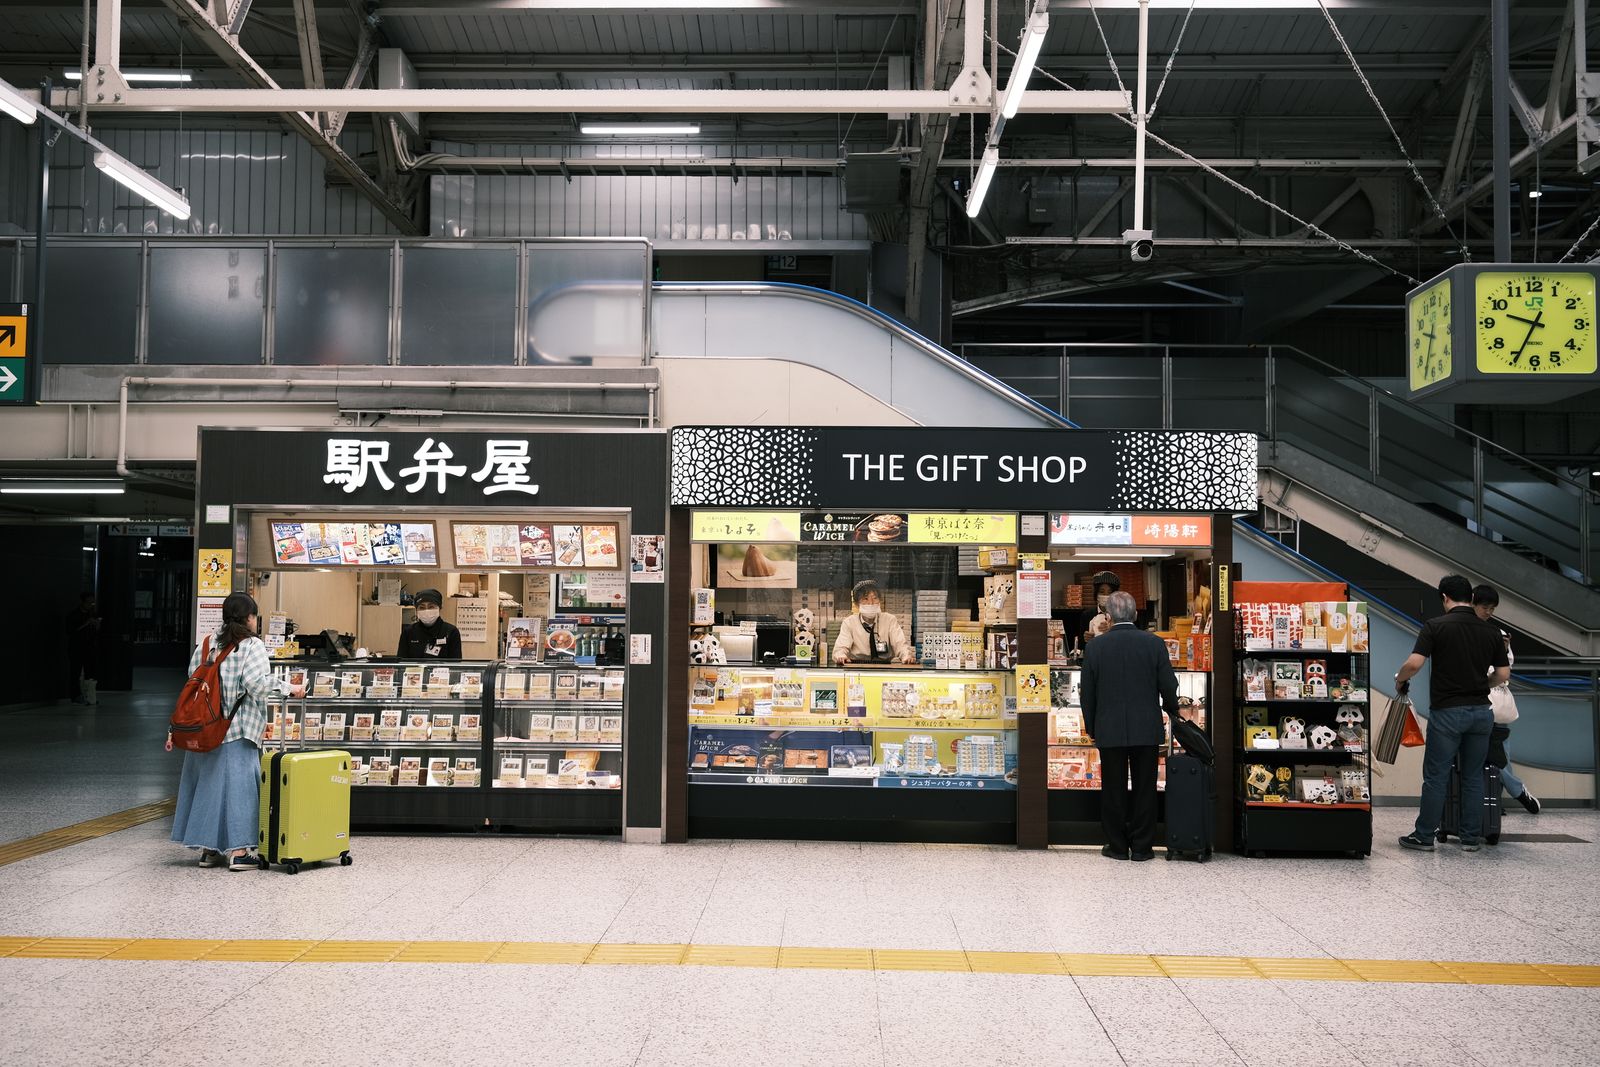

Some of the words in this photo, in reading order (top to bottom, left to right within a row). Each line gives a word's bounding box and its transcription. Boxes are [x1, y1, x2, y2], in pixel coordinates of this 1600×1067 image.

[1507, 286, 1522, 298] 11
[1525, 281, 1543, 293] 12
[1550, 285, 1558, 297] 1
[1491, 299, 1509, 311] 10
[1524, 296, 1544, 307] JR
[1565, 298, 1577, 310] 2
[1484, 317, 1496, 329] 9
[1574, 318, 1586, 331] 3
[1493, 337, 1505, 350] 8
[1564, 338, 1577, 350] 4
[1510, 351, 1522, 363] 7
[1529, 355, 1541, 367] 6
[1549, 351, 1561, 363] 5
[323, 438, 539, 495] 駅弁屋
[842, 453, 905, 482] THE
[916, 454, 989, 483] GIFT
[998, 454, 1087, 484] SHOP
[803, 521, 855, 532] CARAMEL
[924, 516, 985, 530] 東京ばな奈
[813, 531, 845, 541] WICH
[1144, 523, 1199, 538] 崎陽軒
[911, 779, 973, 787] シュガーバターの木
